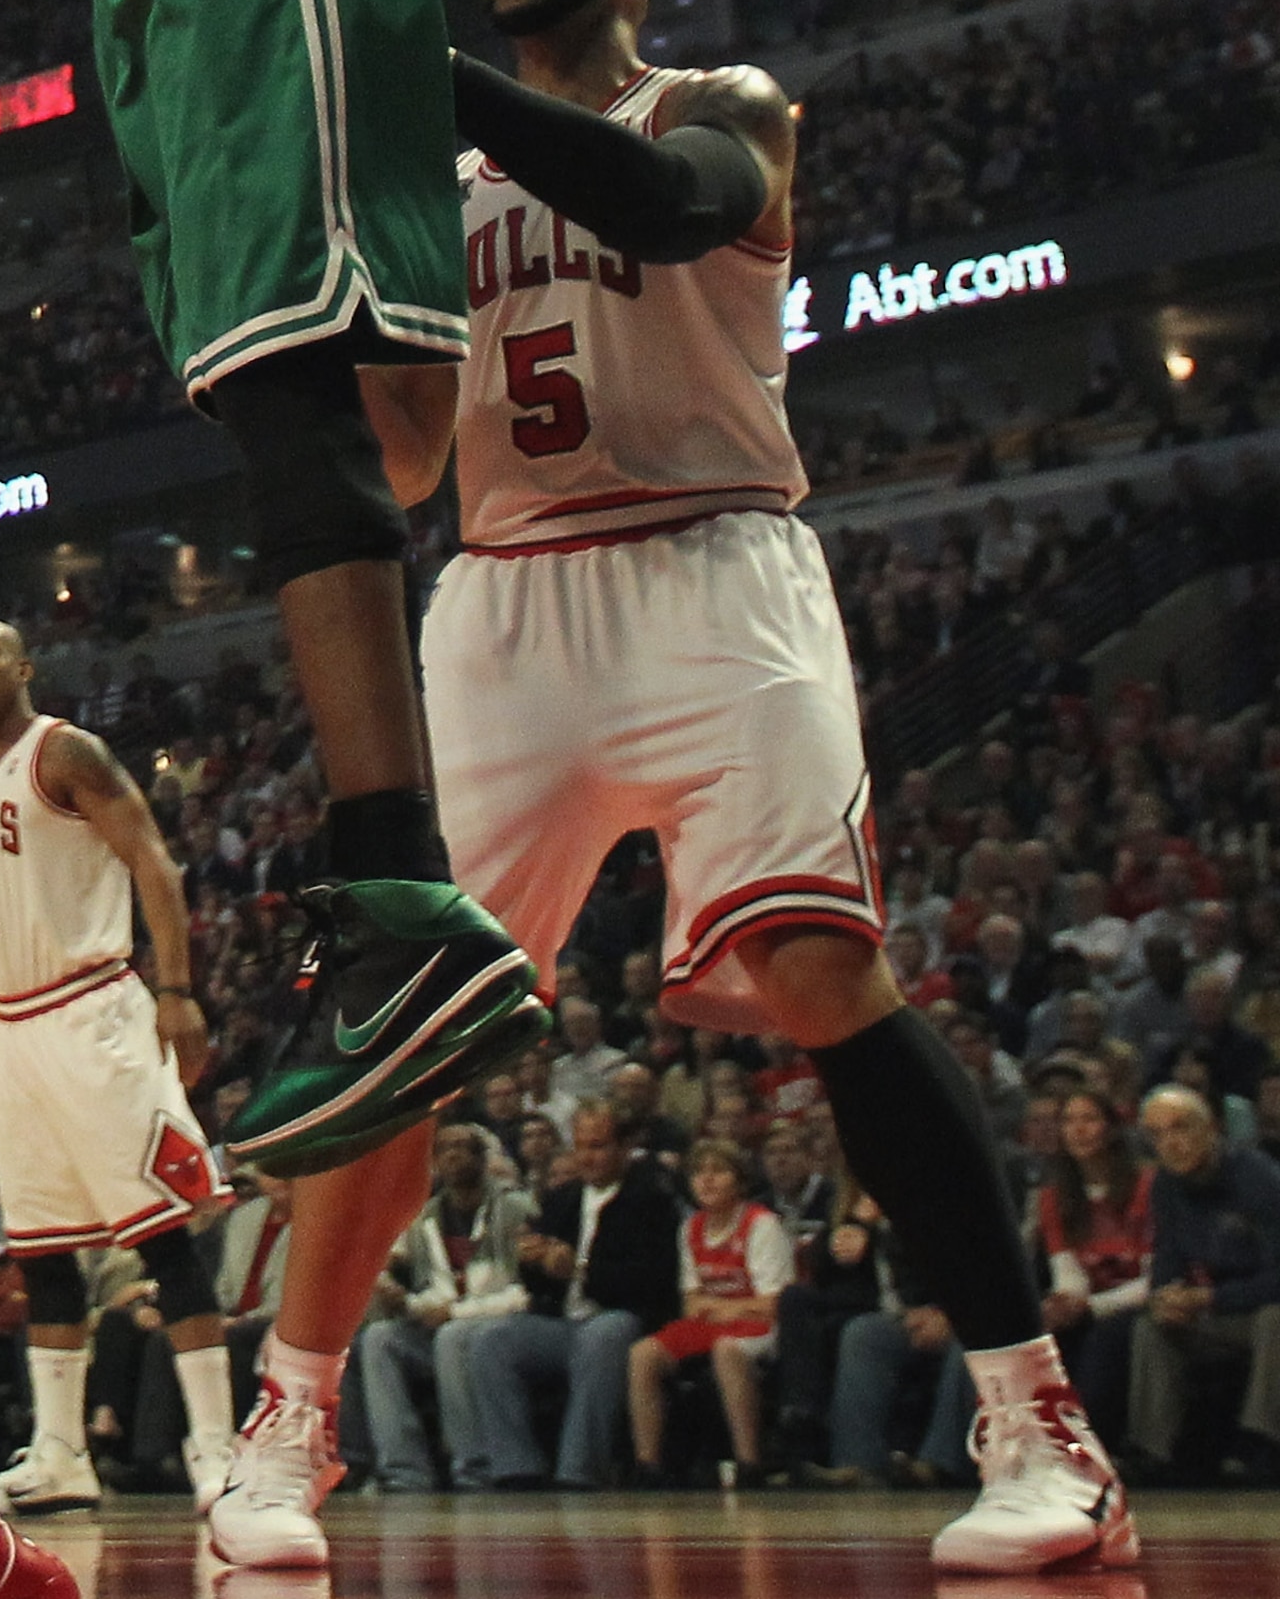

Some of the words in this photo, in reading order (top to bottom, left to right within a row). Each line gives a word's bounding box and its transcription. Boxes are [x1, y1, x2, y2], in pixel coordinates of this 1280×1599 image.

[468, 206, 642, 311] ULLS
[843, 239, 1068, 331] Abt.com
[502, 321, 591, 459] 5
